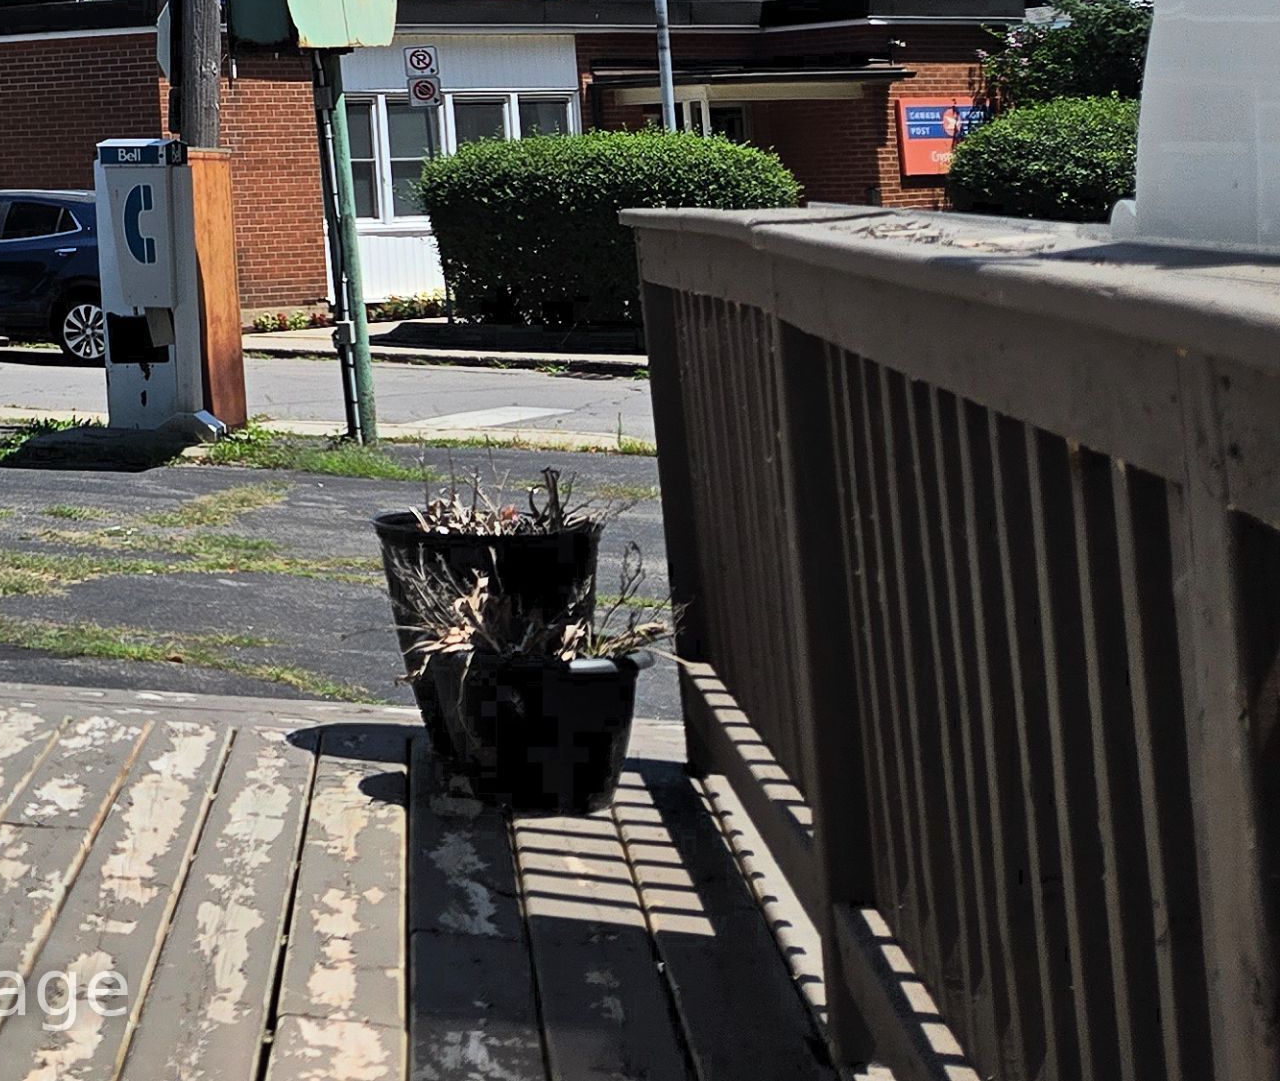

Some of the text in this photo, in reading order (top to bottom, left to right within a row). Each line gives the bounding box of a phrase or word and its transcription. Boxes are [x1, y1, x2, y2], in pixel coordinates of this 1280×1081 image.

[909, 111, 941, 120] CANADA
[911, 127, 930, 135] POST
[118, 148, 141, 162] Bell
